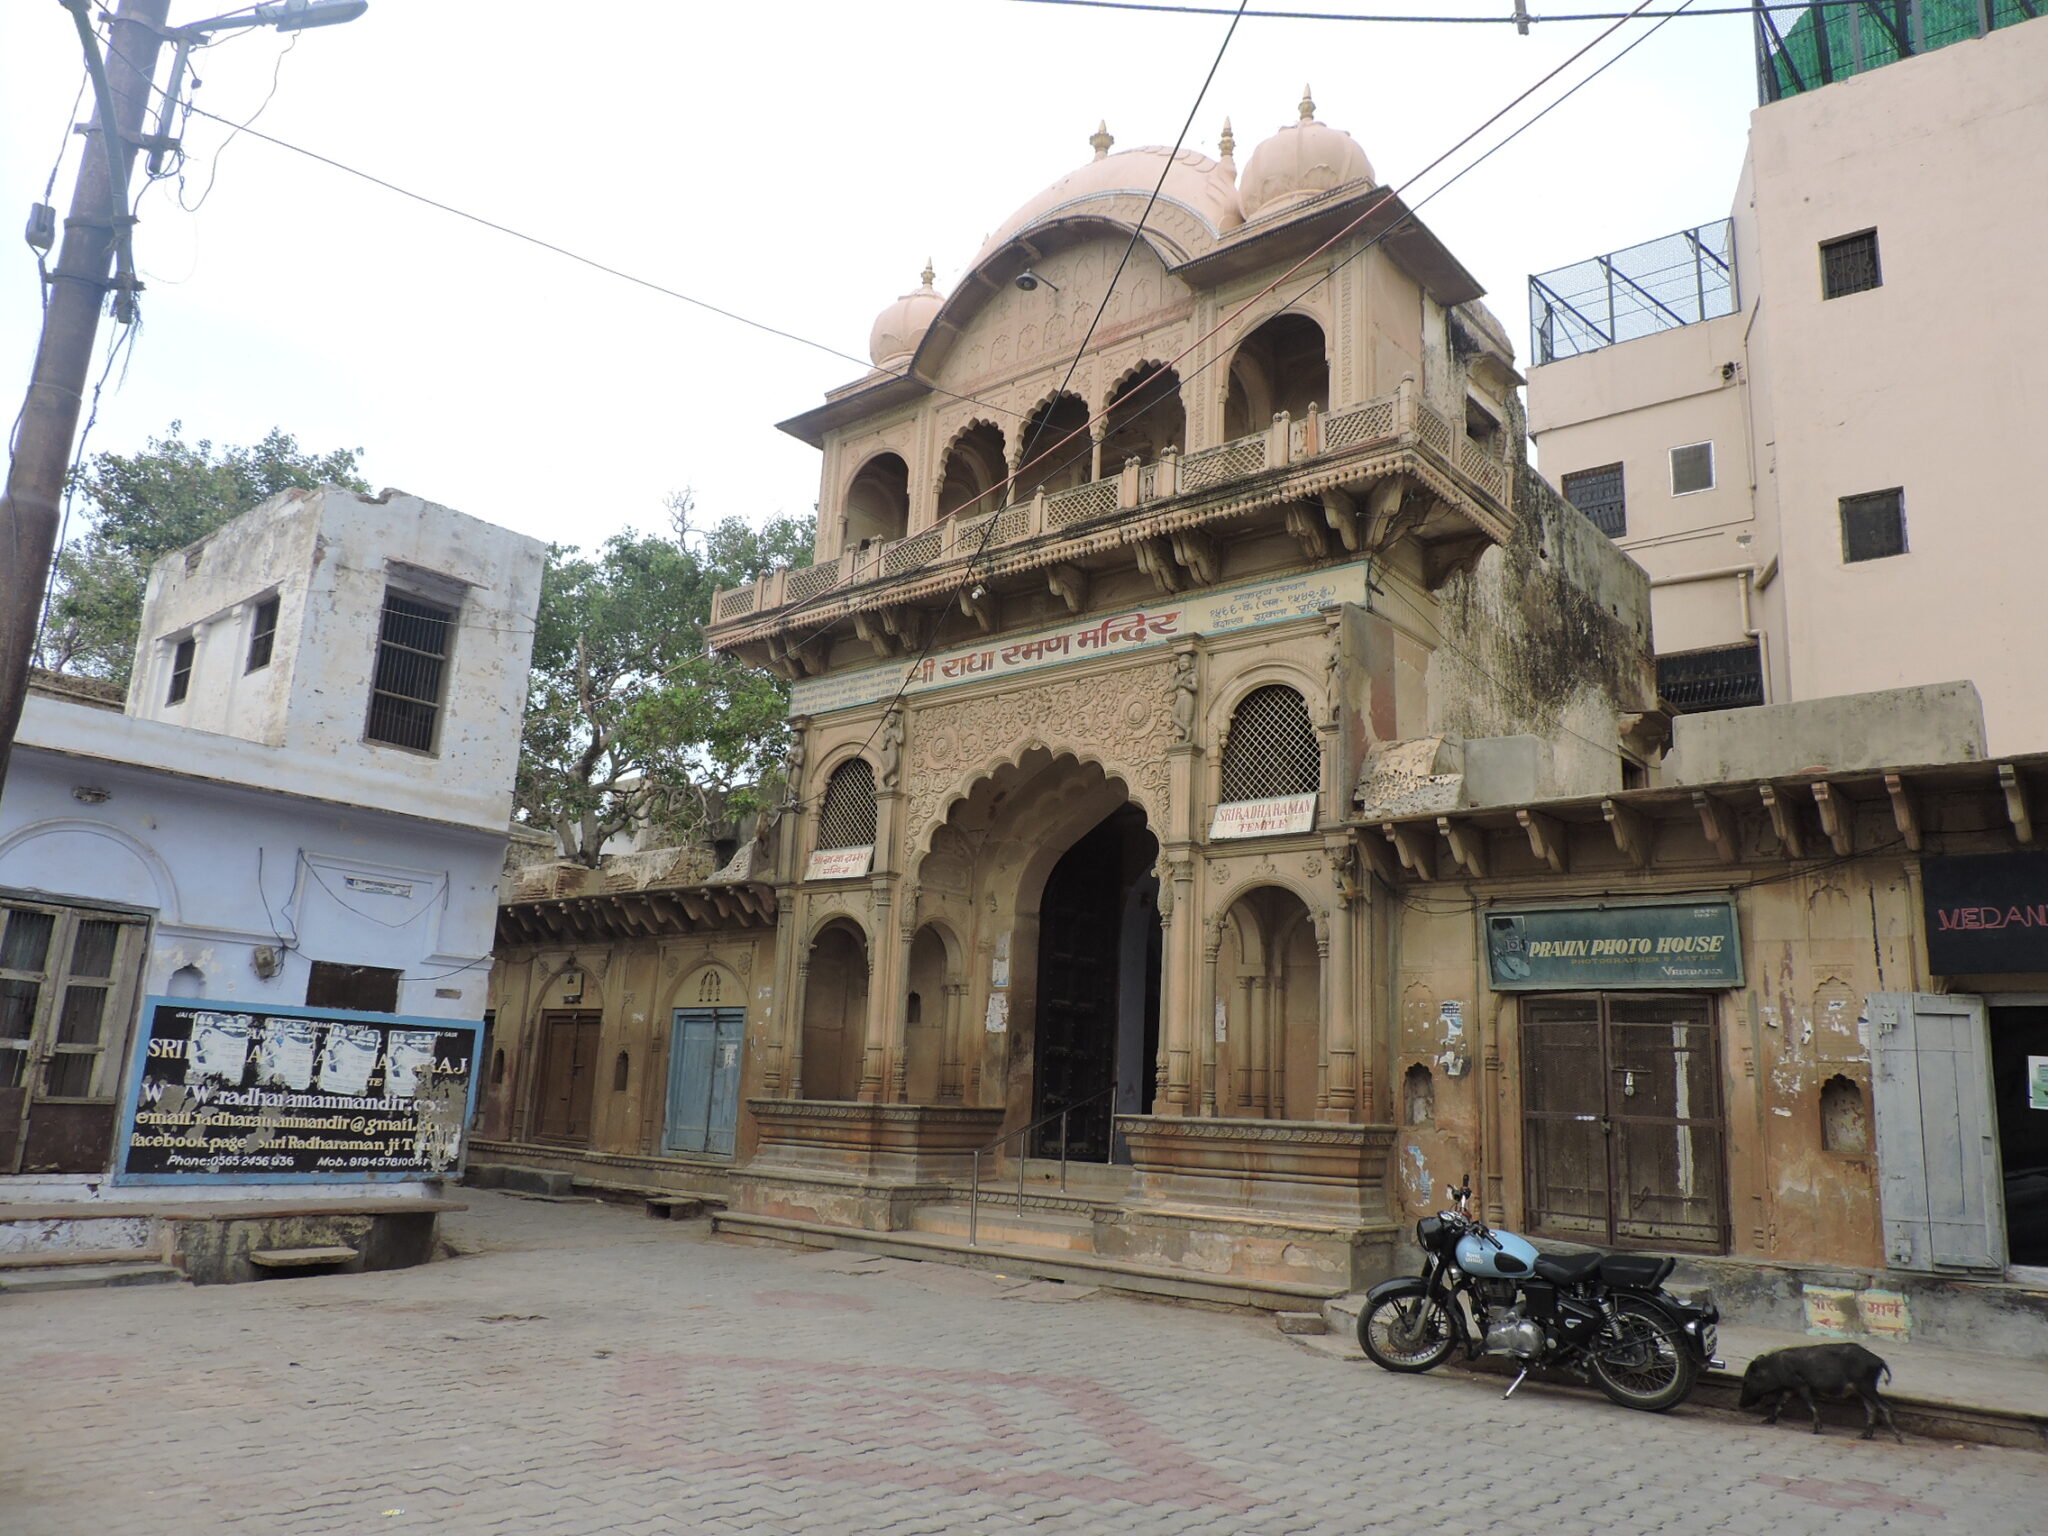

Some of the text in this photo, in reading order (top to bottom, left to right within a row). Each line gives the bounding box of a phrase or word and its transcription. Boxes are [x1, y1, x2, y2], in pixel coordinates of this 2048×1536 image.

[904, 657, 937, 685] श्री
[941, 650, 996, 678] राधा
[1000, 633, 1072, 666] रमण
[1076, 611, 1182, 649] मन्दिर
[1238, 819, 1288, 833] TEMPLE
[1938, 904, 2048, 931] VEDAN
[1590, 938, 1653, 956] PHOTO
[1655, 935, 1726, 954] HOUSE
[1570, 955, 1661, 966] PHOTOGRAPHER
[1675, 954, 1718, 963] ARTIST
[148, 1038, 184, 1059] SRI
[130, 1132, 209, 1148] facebook
[209, 1136, 248, 1154] page
[287, 1135, 385, 1151] Radharaman
[384, 1137, 400, 1156] ji
[316, 1156, 347, 1167] Mob.
